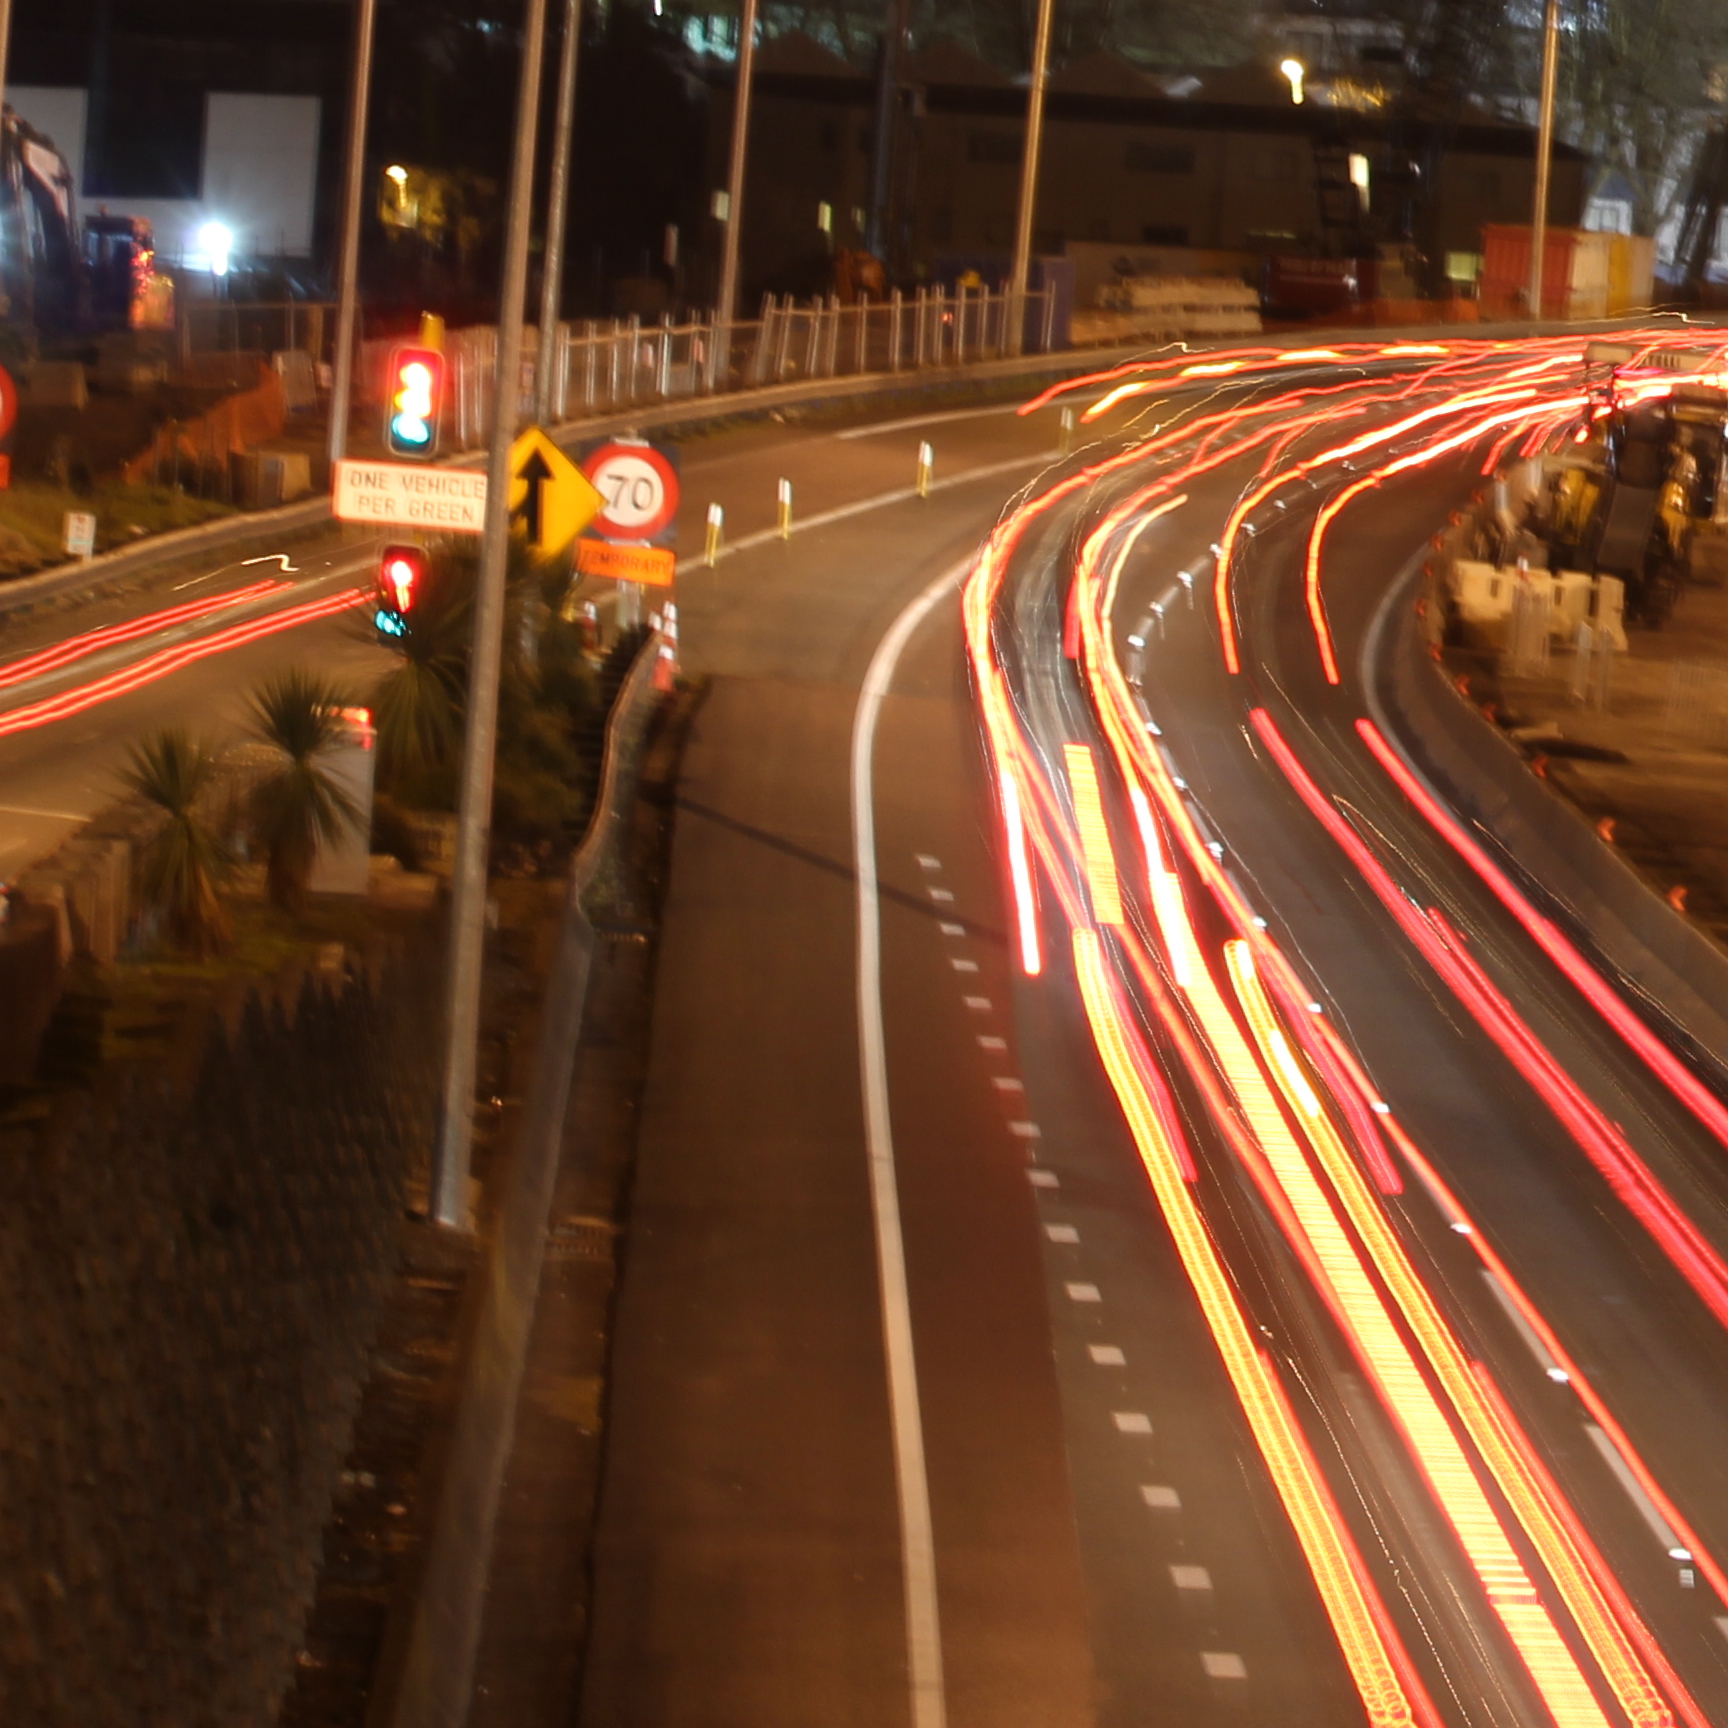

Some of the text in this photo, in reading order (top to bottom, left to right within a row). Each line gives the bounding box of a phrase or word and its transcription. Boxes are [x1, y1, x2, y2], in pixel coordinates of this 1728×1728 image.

[350, 471, 486, 500] ONE VEHICLE
[606, 474, 655, 511] 70
[357, 495, 475, 523] PER GREEN
[580, 549, 671, 575] TEMPORARY
